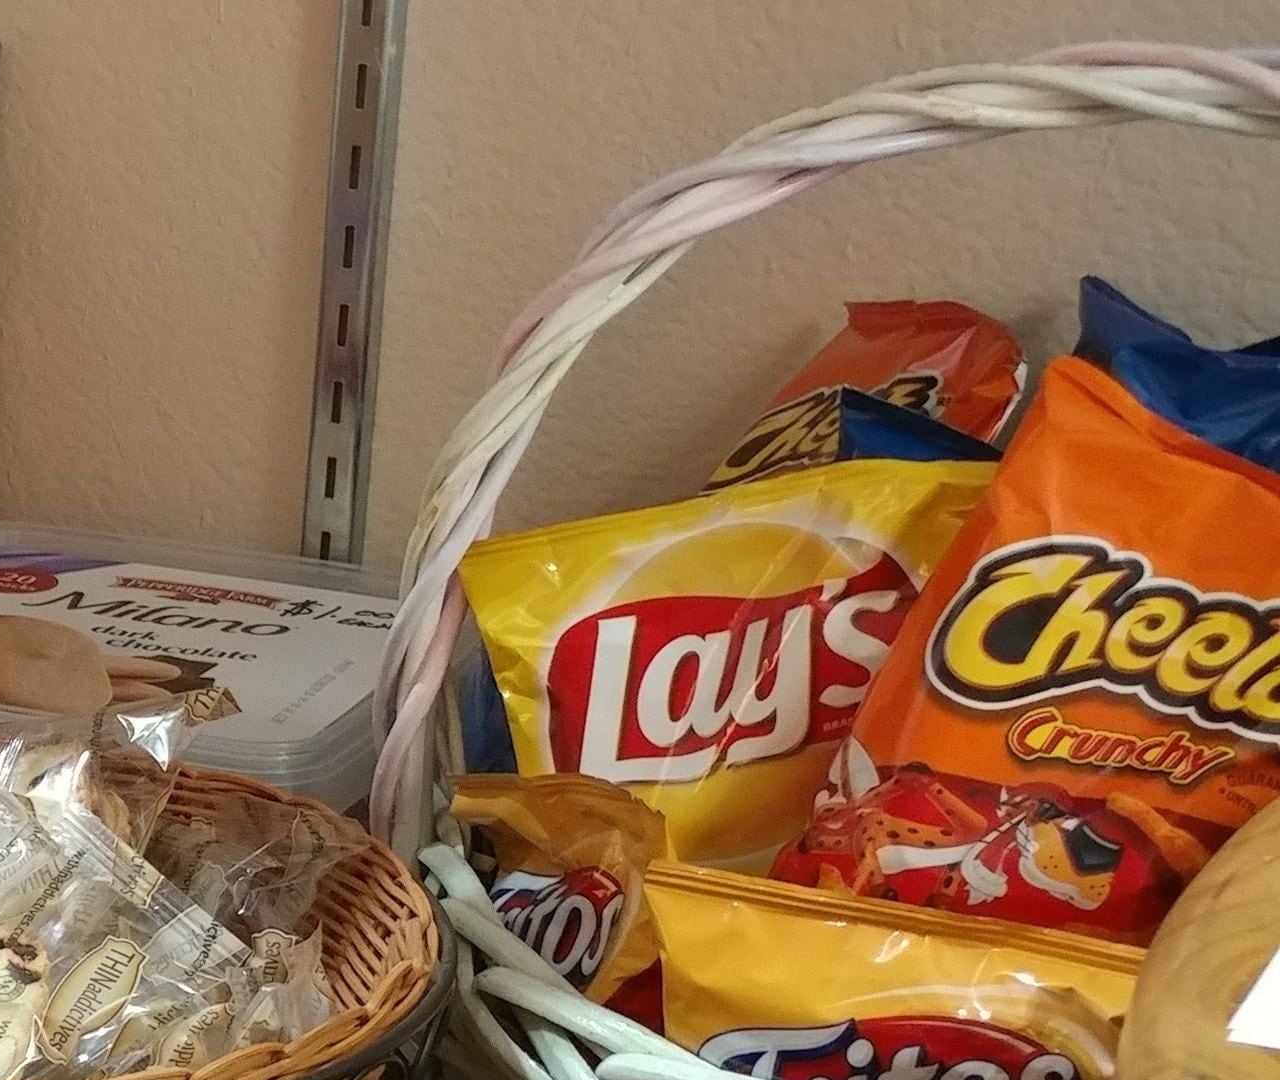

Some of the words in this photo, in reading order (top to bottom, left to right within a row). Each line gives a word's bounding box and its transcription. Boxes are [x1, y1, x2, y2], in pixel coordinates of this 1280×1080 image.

[22, 589, 292, 638] Milano
[90, 622, 158, 642] dark
[105, 636, 259, 663] chocolate
[579, 577, 900, 784] Lay's
[1012, 715, 1231, 783] Crunchy
[49, 938, 138, 1054] THINaddictives
